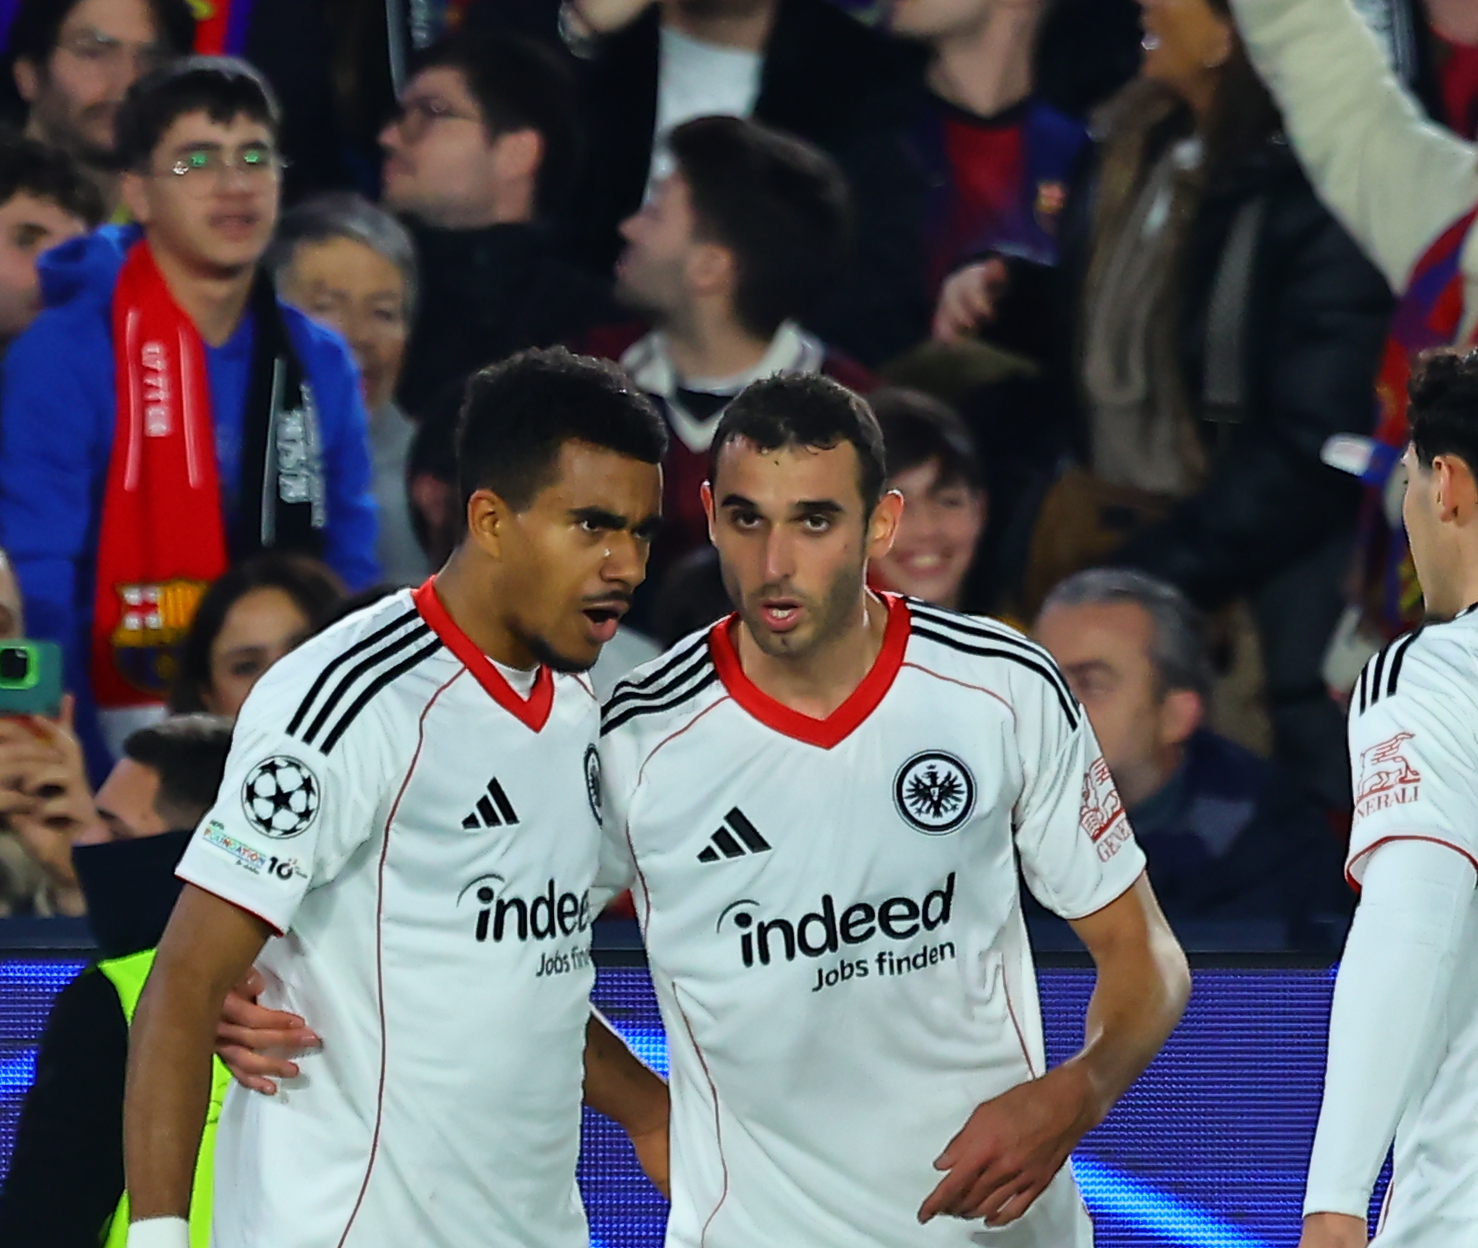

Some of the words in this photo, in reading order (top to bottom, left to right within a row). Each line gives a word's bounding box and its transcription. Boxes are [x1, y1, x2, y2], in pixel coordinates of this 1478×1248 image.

[717, 871, 956, 968] indeed
[536, 952, 570, 977] Jobs
[812, 960, 869, 992] Jobs
[875, 941, 955, 976] finden
